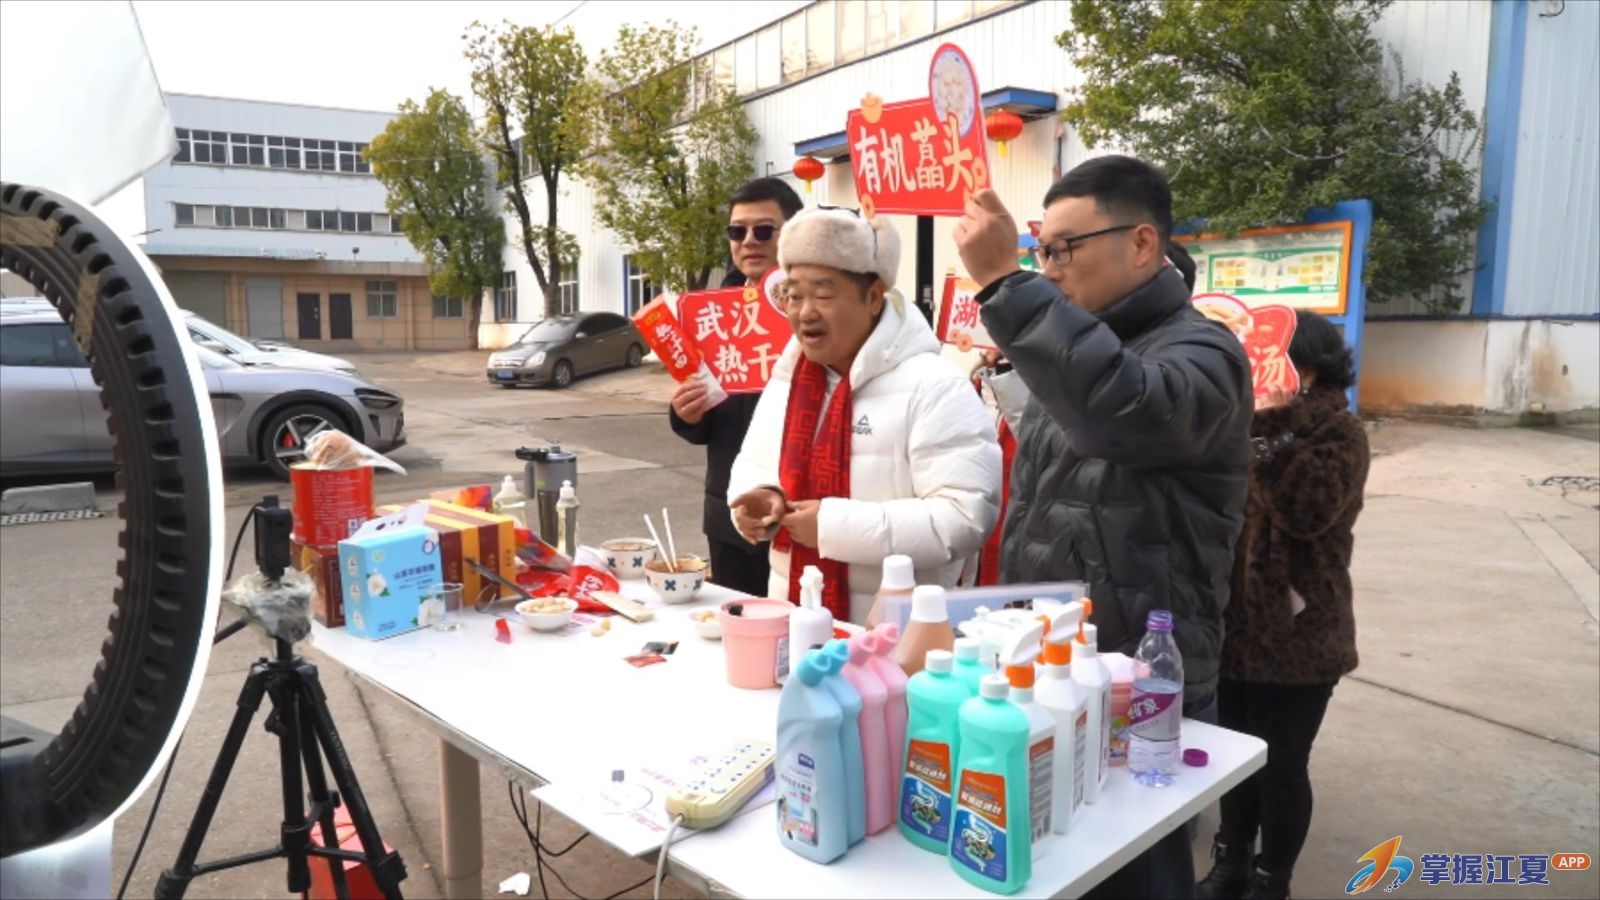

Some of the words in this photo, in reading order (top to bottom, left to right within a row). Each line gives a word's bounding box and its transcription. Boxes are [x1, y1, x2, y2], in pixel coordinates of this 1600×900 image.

[854, 112, 974, 194] 有机藠头
[694, 301, 770, 341] 武汉
[713, 342, 780, 383] 热干
[1248, 344, 1286, 393] 汤
